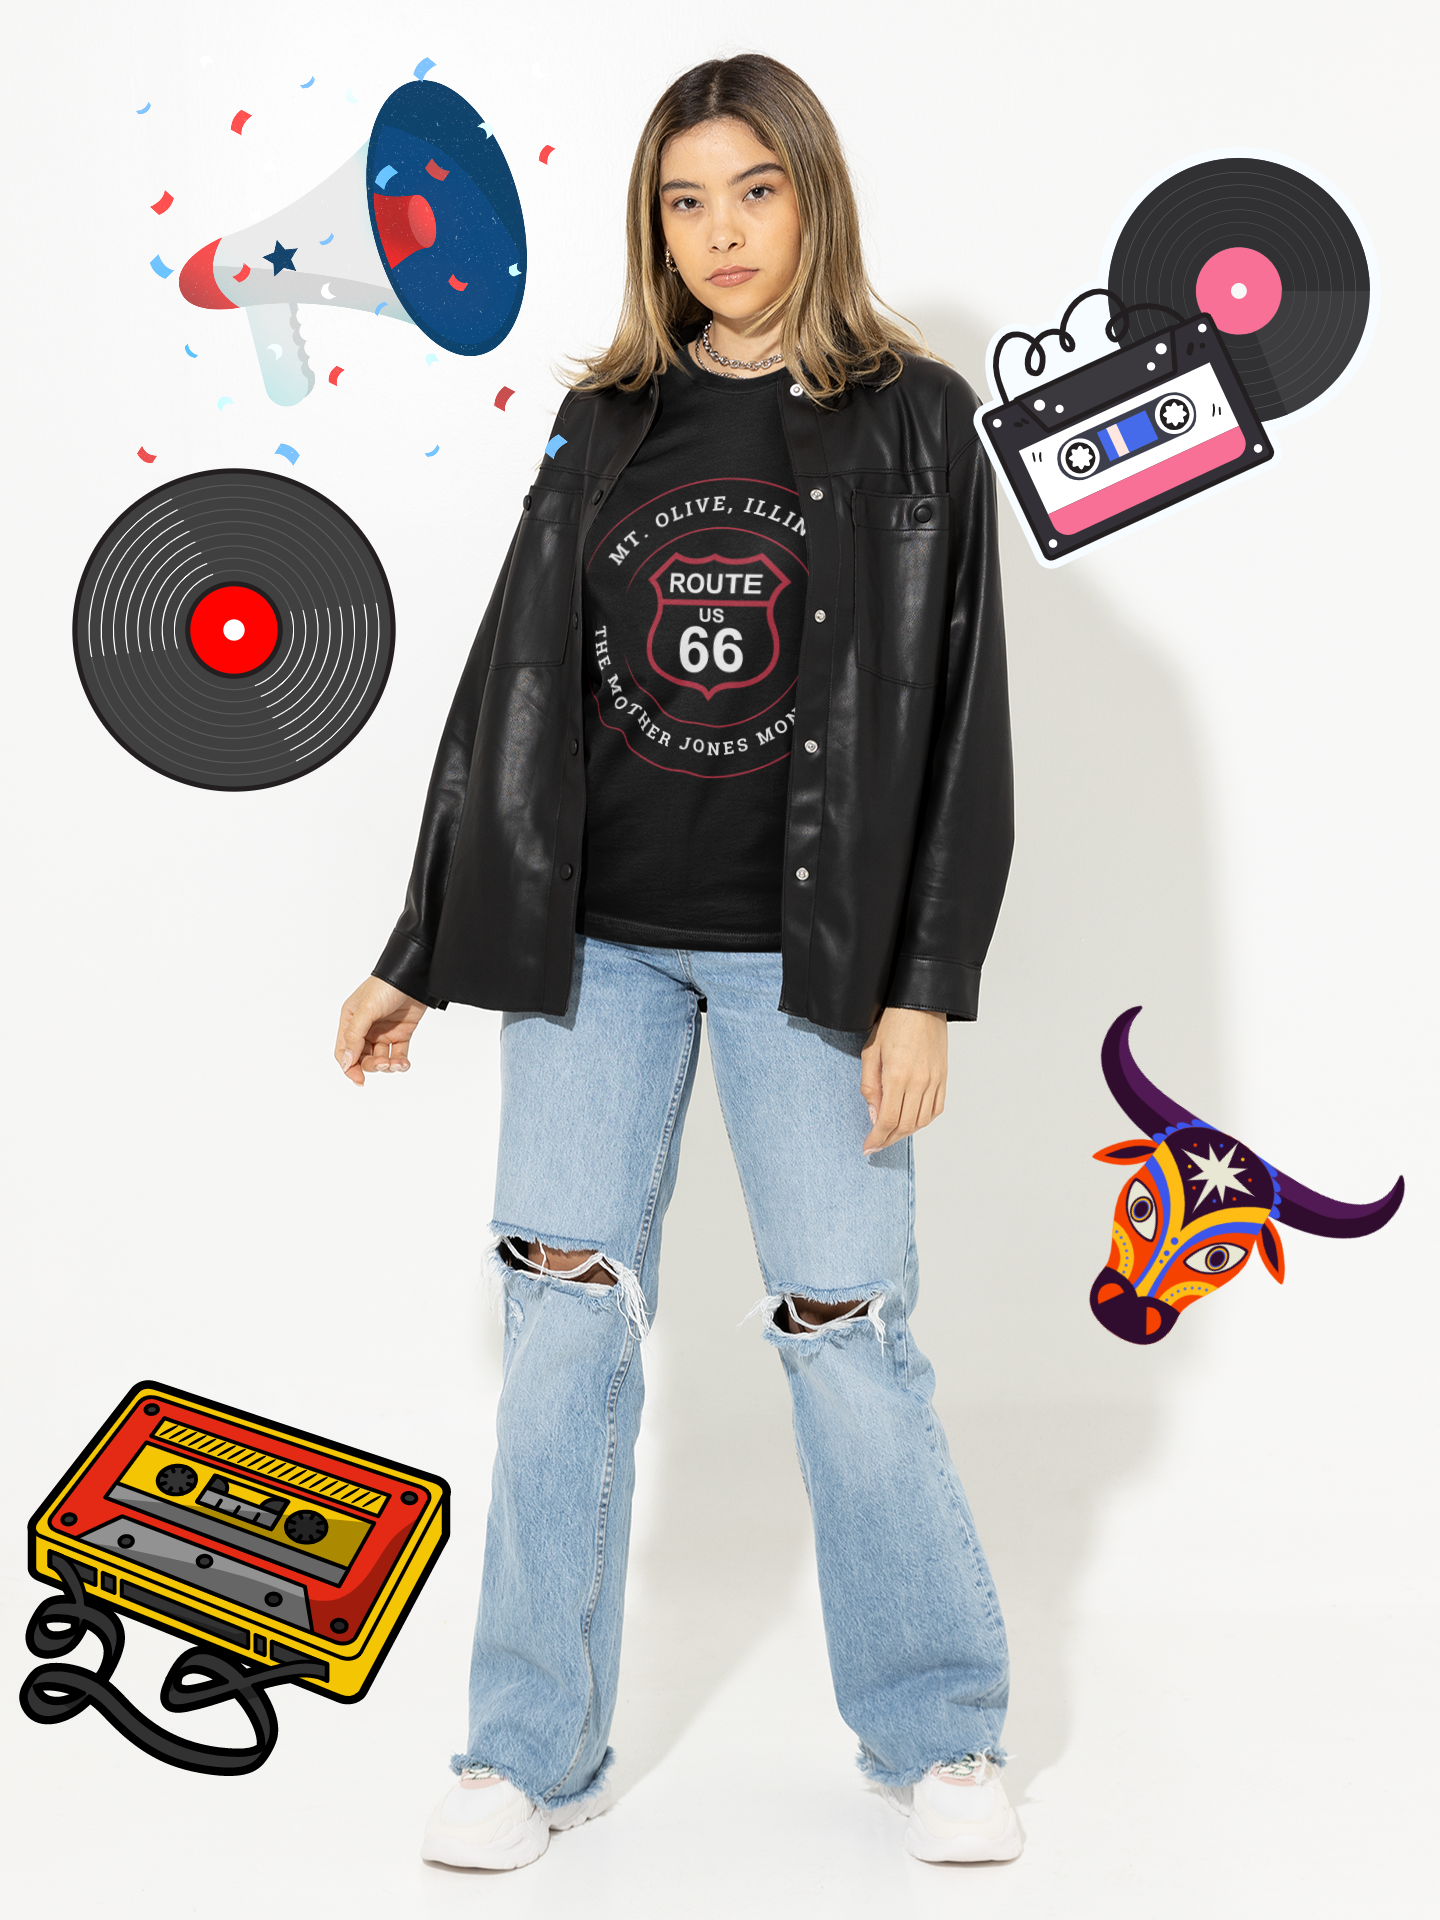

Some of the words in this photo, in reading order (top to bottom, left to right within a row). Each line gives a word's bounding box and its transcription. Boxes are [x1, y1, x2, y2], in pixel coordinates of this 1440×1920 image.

[608, 530, 649, 566] MT.
[655, 496, 733, 528] OLIVE,
[669, 573, 764, 595] ROUTE
[698, 608, 725, 623] US
[679, 626, 744, 673] 66
[595, 626, 612, 671] THE
[607, 674, 672, 747] MOTHER
[679, 737, 749, 756] JONES
